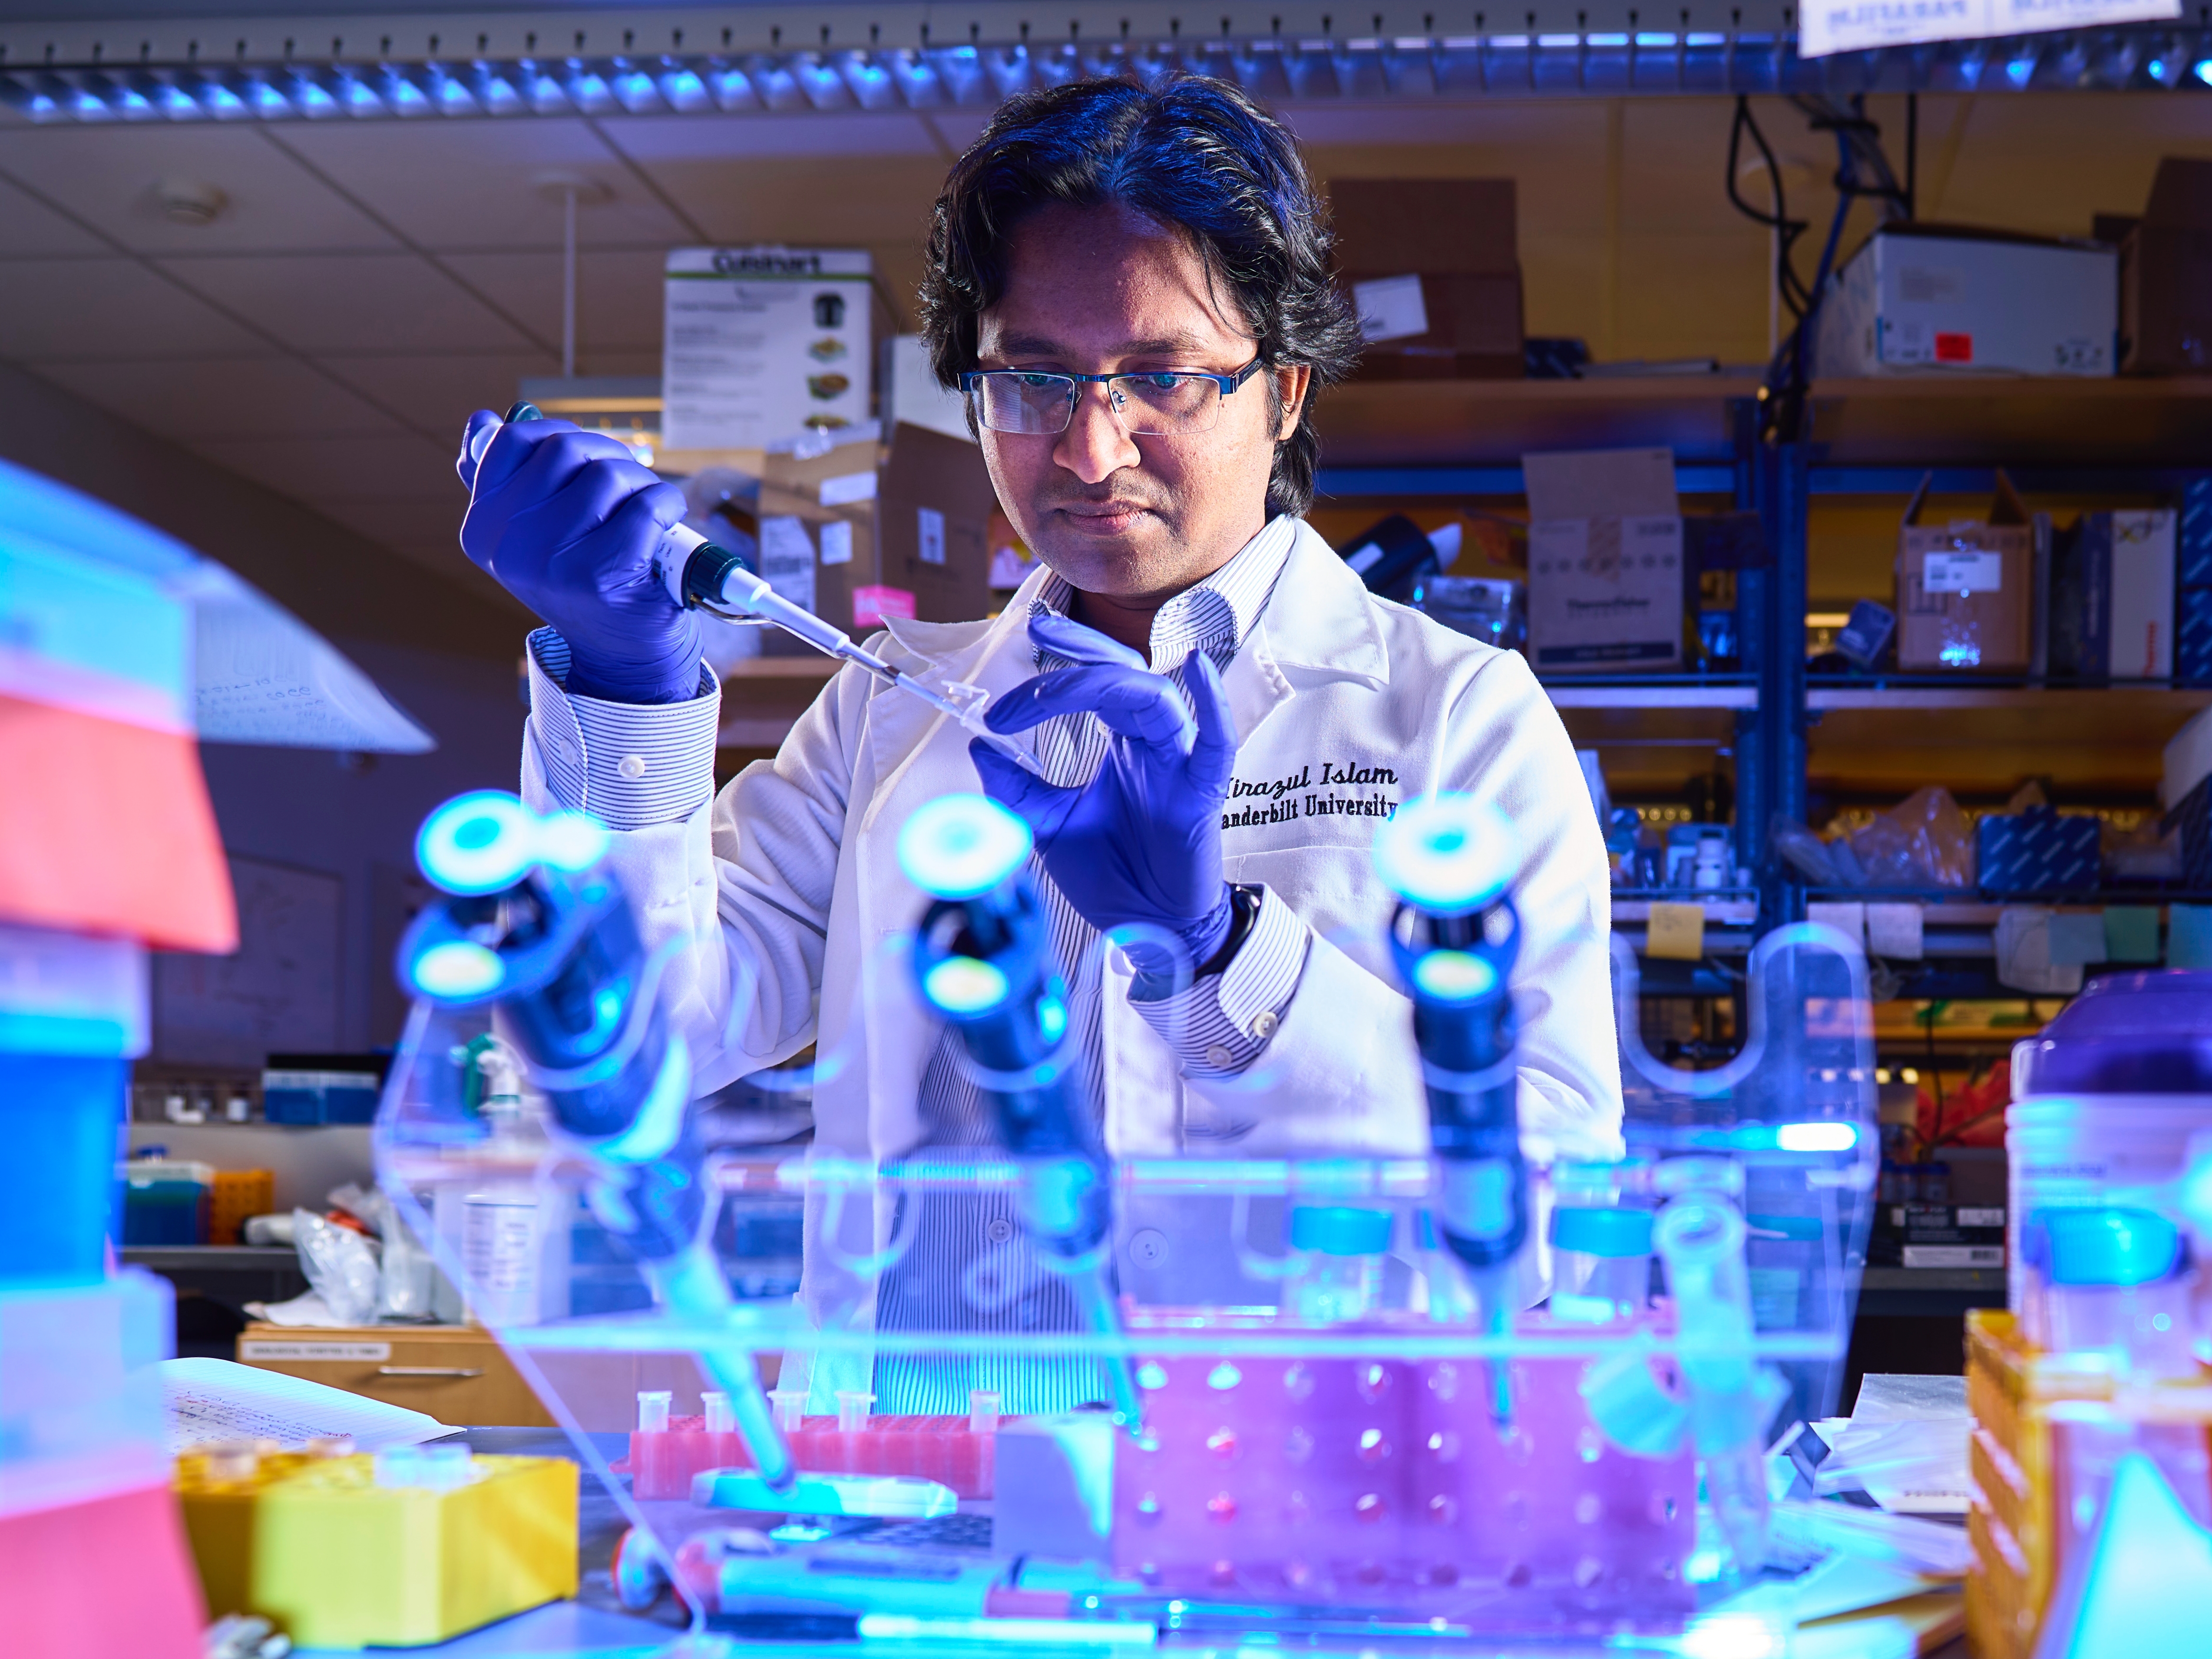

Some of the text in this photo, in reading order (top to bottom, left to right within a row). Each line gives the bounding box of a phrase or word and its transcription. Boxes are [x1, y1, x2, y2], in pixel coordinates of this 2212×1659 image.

[1320, 762, 1398, 785] Islam
[1221, 793, 1399, 830] anderbilt University
